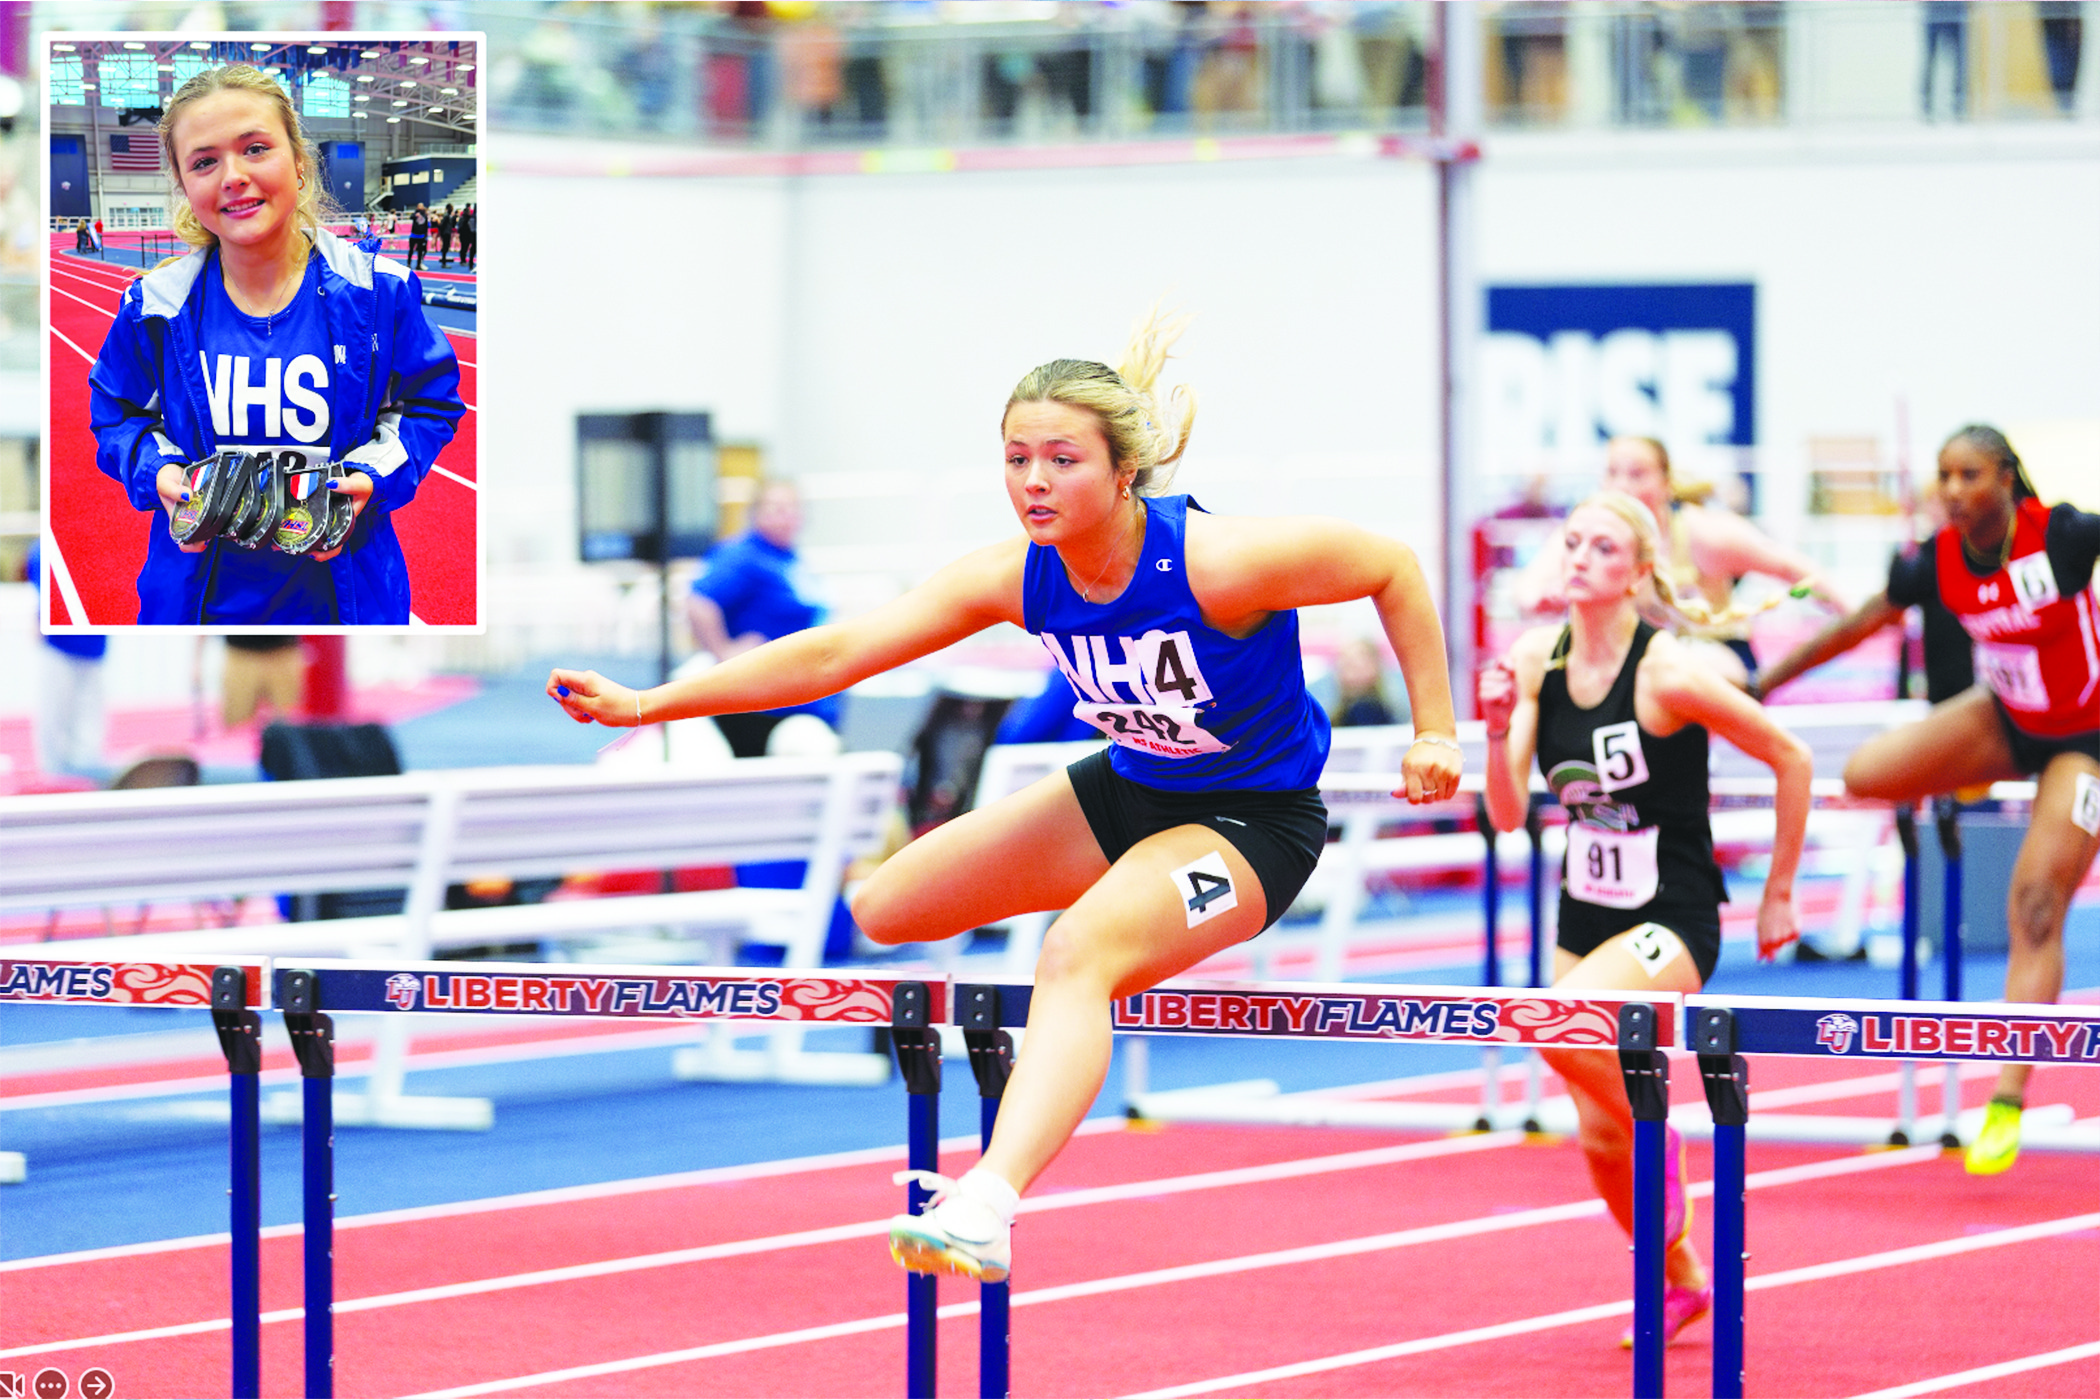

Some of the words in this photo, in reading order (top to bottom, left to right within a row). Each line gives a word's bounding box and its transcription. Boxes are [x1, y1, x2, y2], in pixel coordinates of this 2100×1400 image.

[1155, 638, 1197, 701] 4
[1096, 709, 1197, 744] 242
[1148, 741, 1203, 755] ATHLETIC
[1603, 732, 1635, 780] 5
[1588, 841, 1622, 882] 91
[1187, 870, 1231, 913] 4
[1634, 930, 1661, 961] 5
[424, 975, 611, 1011] LIBERTY
[610, 979, 783, 1016] FLAMES
[1114, 992, 1316, 1032] LIBERTY
[1315, 998, 1500, 1037] FLAMES
[1862, 1016, 2082, 1058] LIBERTY
